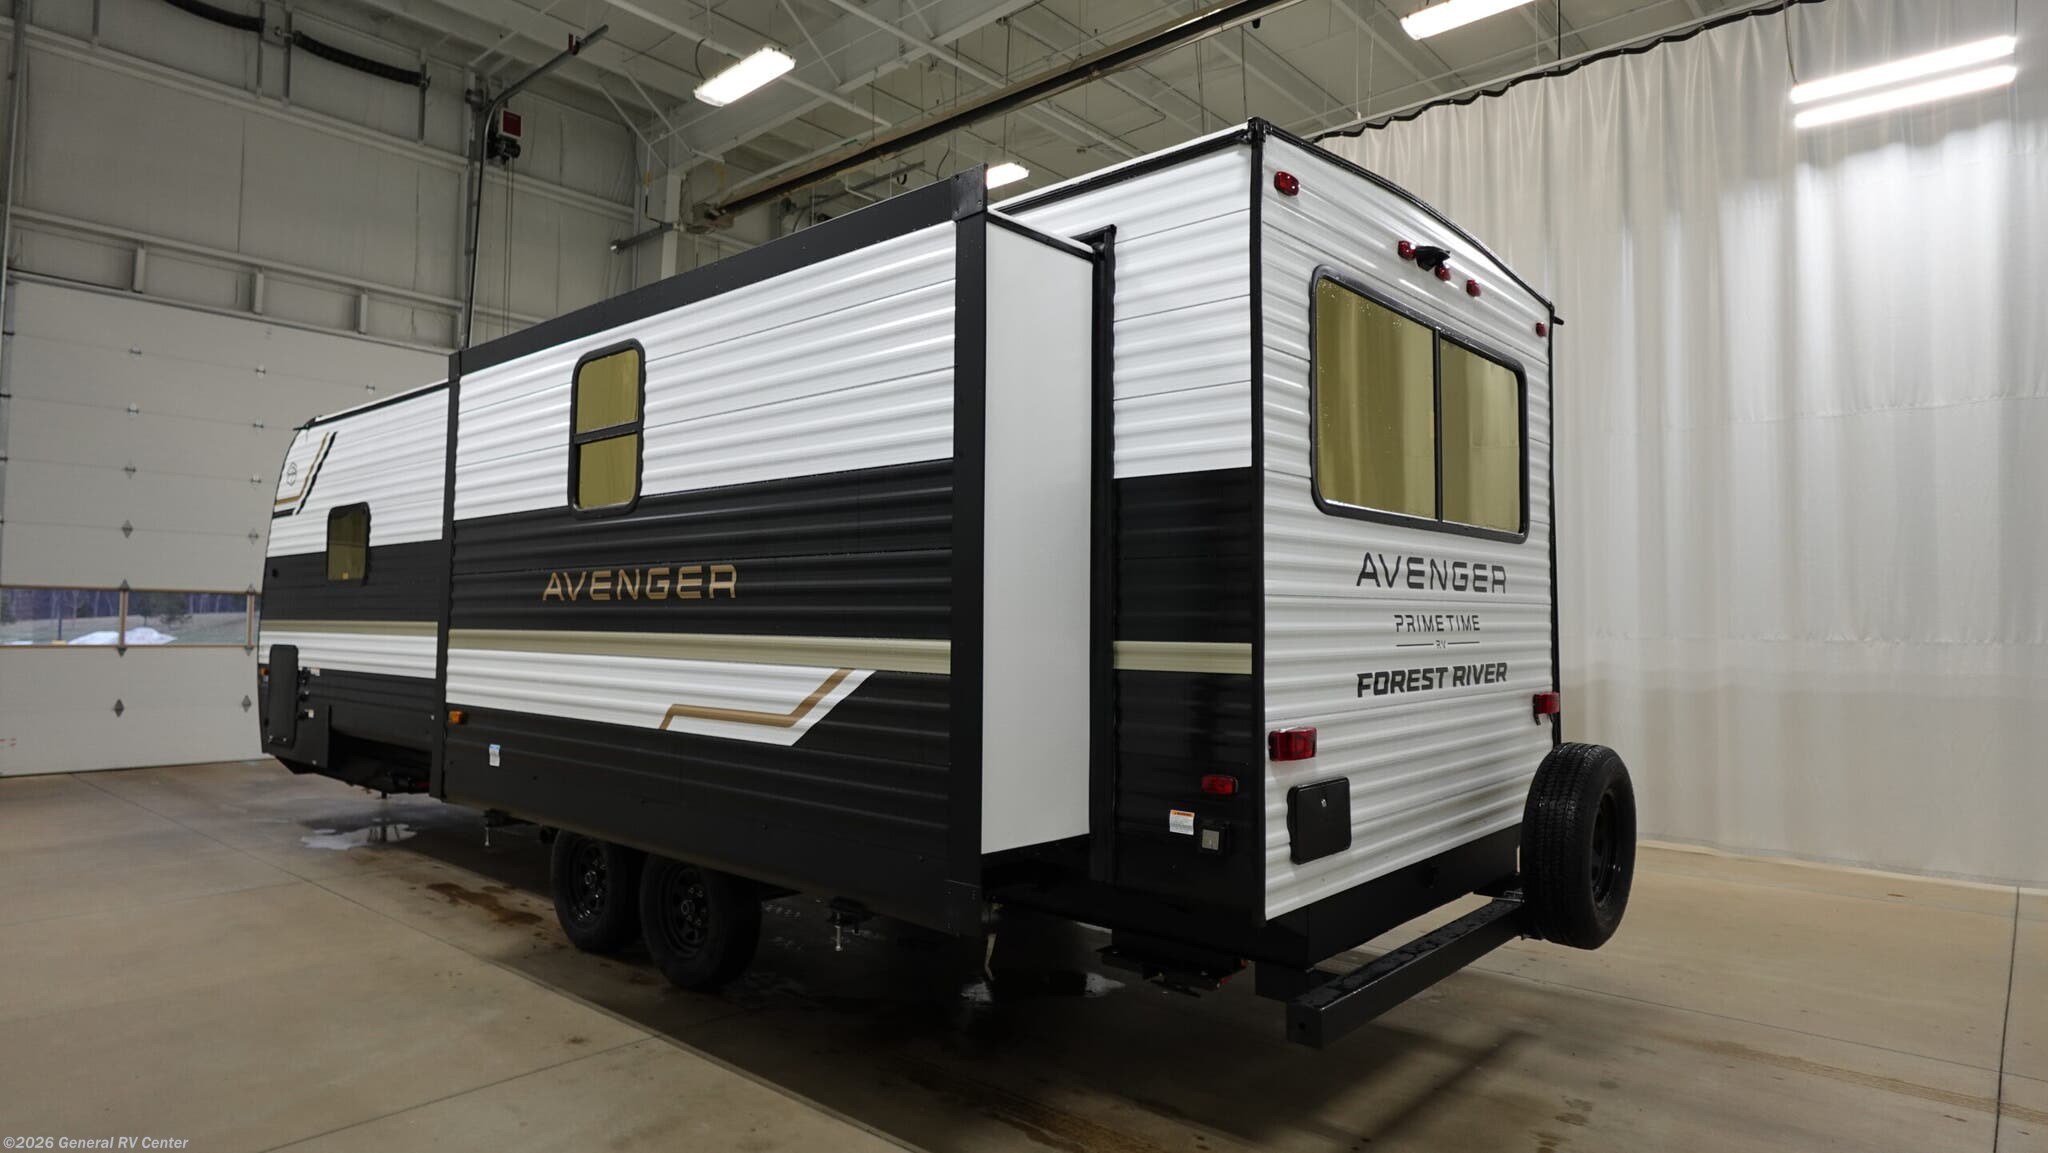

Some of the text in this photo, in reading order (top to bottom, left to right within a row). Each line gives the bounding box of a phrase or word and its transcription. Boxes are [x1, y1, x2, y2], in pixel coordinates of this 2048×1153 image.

[543, 563, 737, 602] AVENGER
[1356, 552, 1507, 594] AVENGER
[1356, 662, 1508, 698] FOREST RIVER
